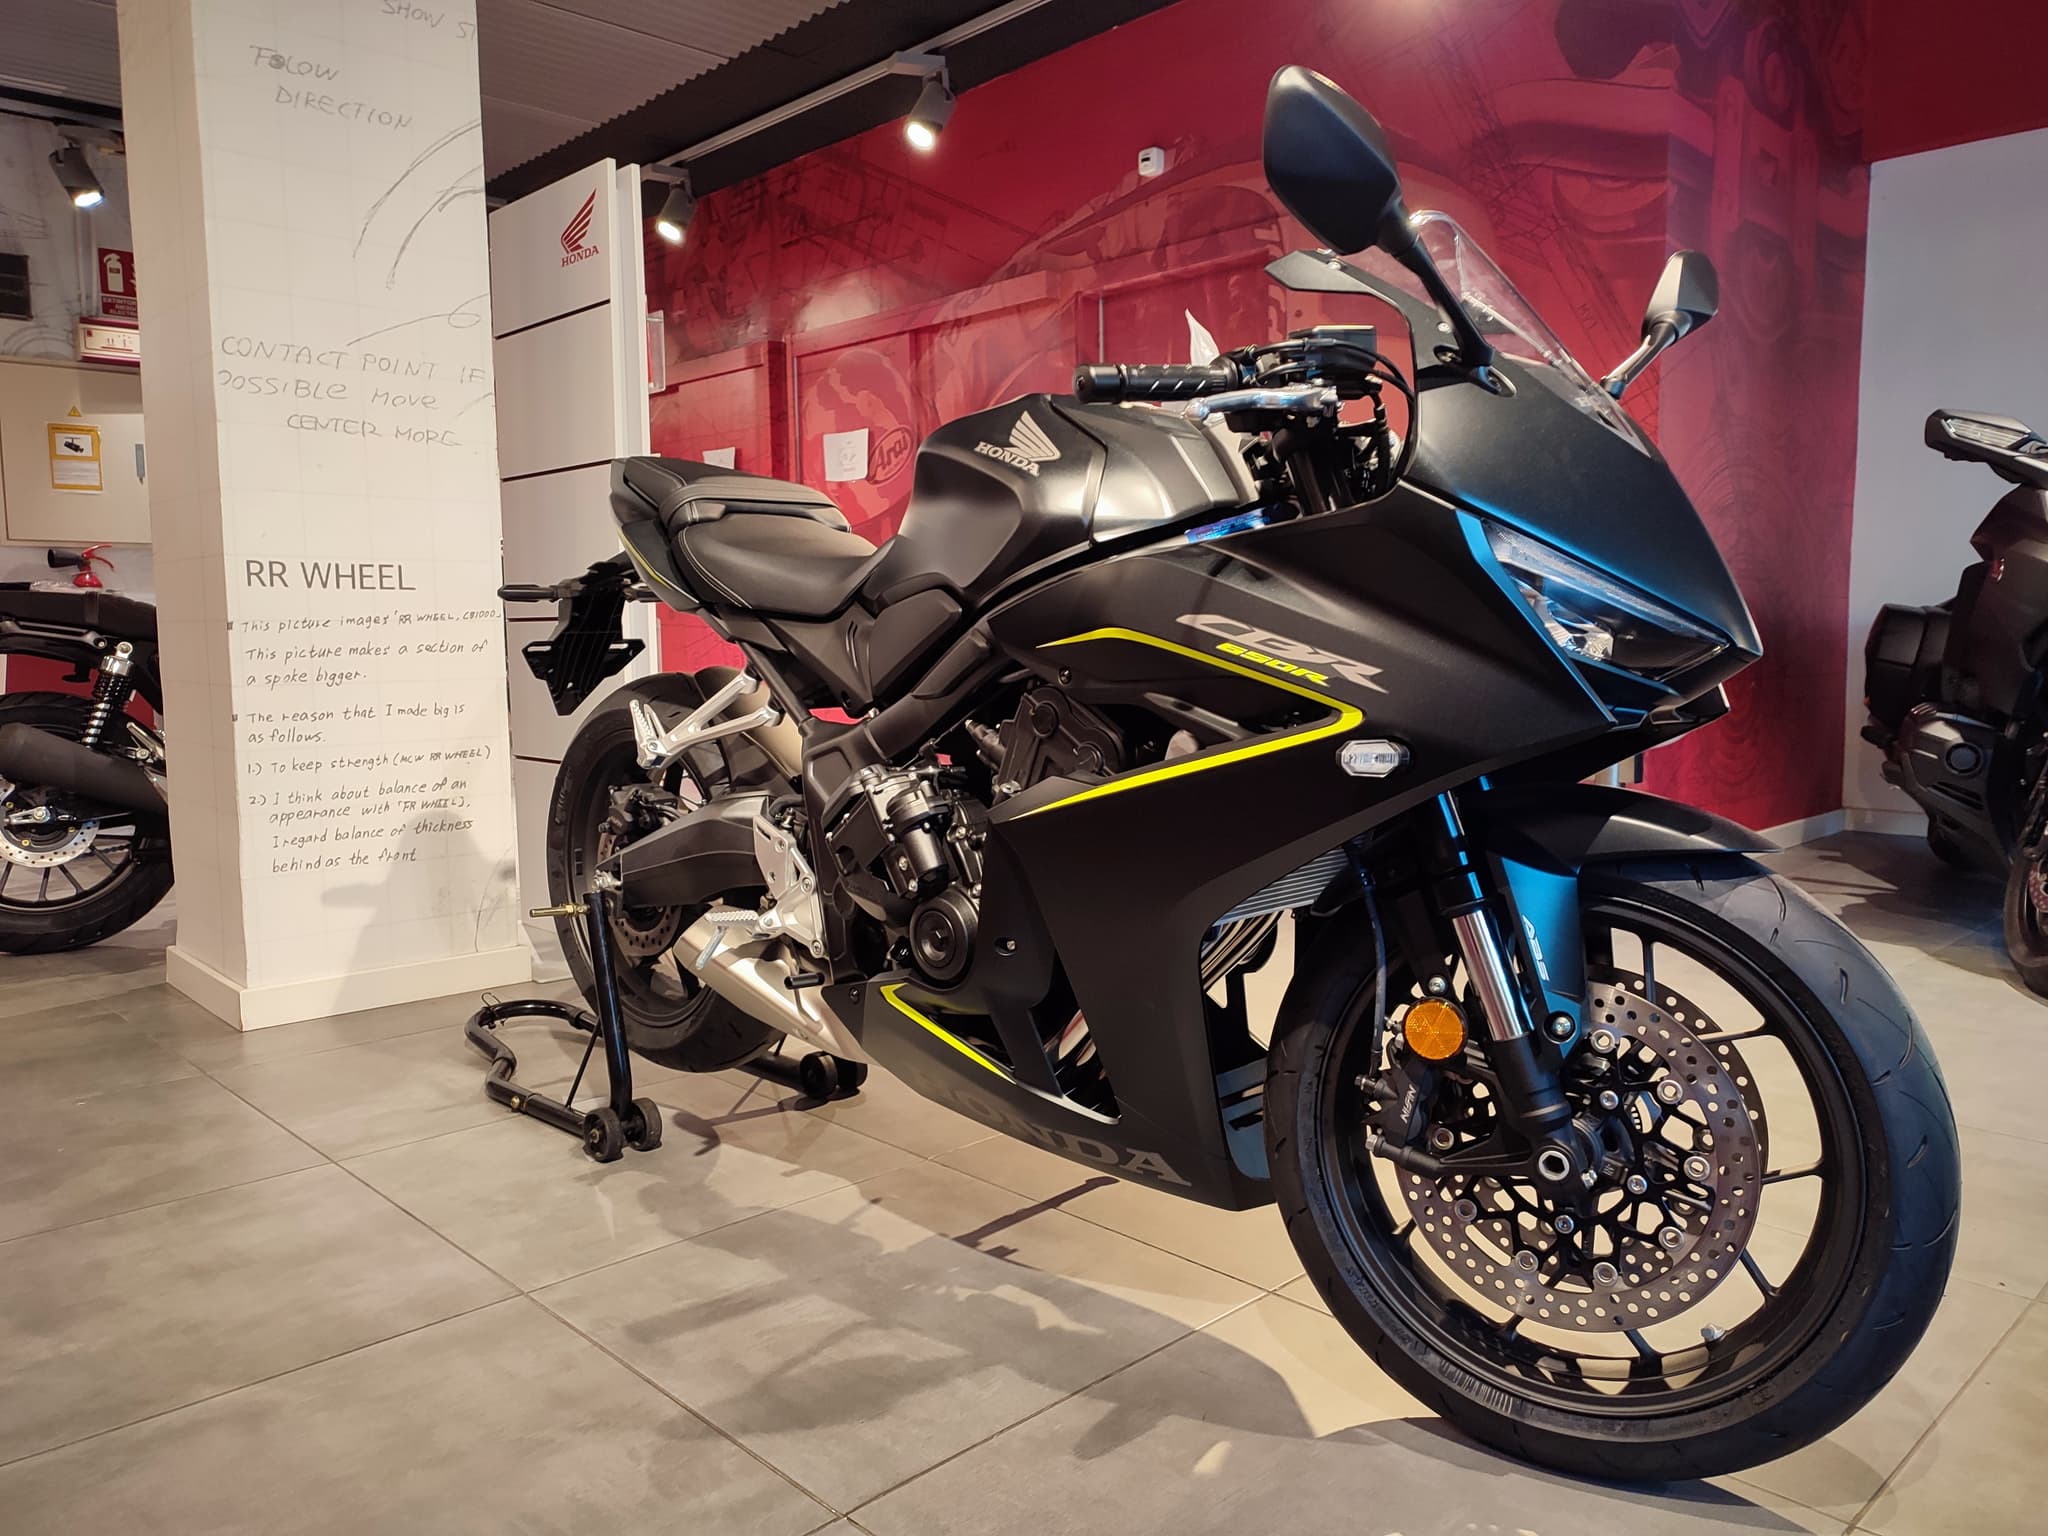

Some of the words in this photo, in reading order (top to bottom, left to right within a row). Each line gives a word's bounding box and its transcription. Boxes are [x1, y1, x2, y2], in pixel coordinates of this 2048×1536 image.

[275, 85, 413, 129] DIRECTION
[560, 245, 600, 268] HONDA
[221, 336, 349, 370] CONTACT
[362, 353, 438, 380] POINT
[286, 413, 382, 438] CENTER
[974, 440, 1041, 478] HONDA
[245, 559, 290, 589] RR
[300, 561, 417, 591] WHEEL
[242, 620, 271, 633] This
[278, 617, 331, 634] picture
[340, 614, 390, 629] images
[245, 647, 277, 660] This
[284, 644, 342, 665] picture
[348, 641, 391, 656] makes
[398, 645, 408, 655] a
[415, 639, 464, 654] section
[471, 639, 488, 652] of
[1175, 613, 1391, 695] CBR
[1216, 641, 1331, 688] 650R
[246, 675, 256, 686] a
[264, 667, 307, 691] spoke
[246, 712, 273, 724] The
[281, 711, 334, 722] reason
[342, 704, 376, 720] that
[397, 702, 428, 717] made
[433, 701, 450, 718] big
[248, 733, 265, 744] as
[271, 762, 286, 774] To
[291, 756, 322, 774] keep
[330, 753, 389, 771] strength
[287, 788, 322, 805] think
[331, 784, 370, 801] about
[378, 778, 428, 796] balance
[431, 776, 448, 793] of
[450, 779, 467, 790] an
[269, 805, 351, 827] appearance
[361, 800, 390, 816] with
[282, 827, 328, 849] regard
[334, 824, 385, 841] balance
[390, 823, 407, 836] of
[414, 818, 474, 835] thickness
[272, 855, 321, 873] behind
[324, 855, 341, 868] as
[349, 848, 369, 865] the
[378, 847, 417, 862] front
[1521, 914, 1550, 982] ABS
